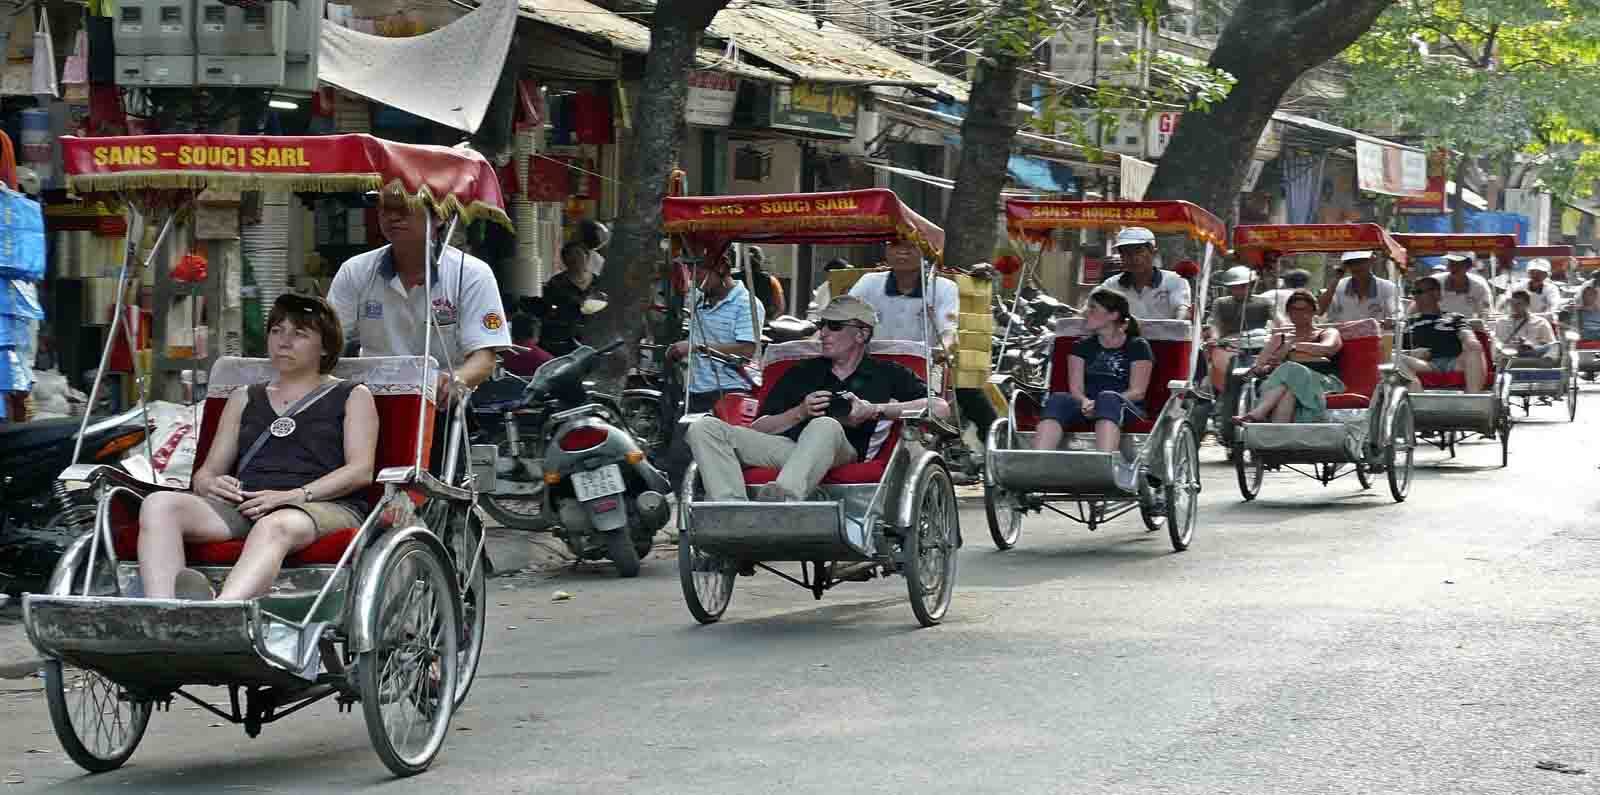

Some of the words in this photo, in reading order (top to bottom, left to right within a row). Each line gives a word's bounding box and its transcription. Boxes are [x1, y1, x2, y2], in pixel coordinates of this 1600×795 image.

[94, 145, 157, 166] SANS
[178, 145, 246, 167] SOUCI
[250, 147, 310, 167] SARL
[759, 201, 811, 214] SOUCI
[815, 198, 857, 210] SARL
